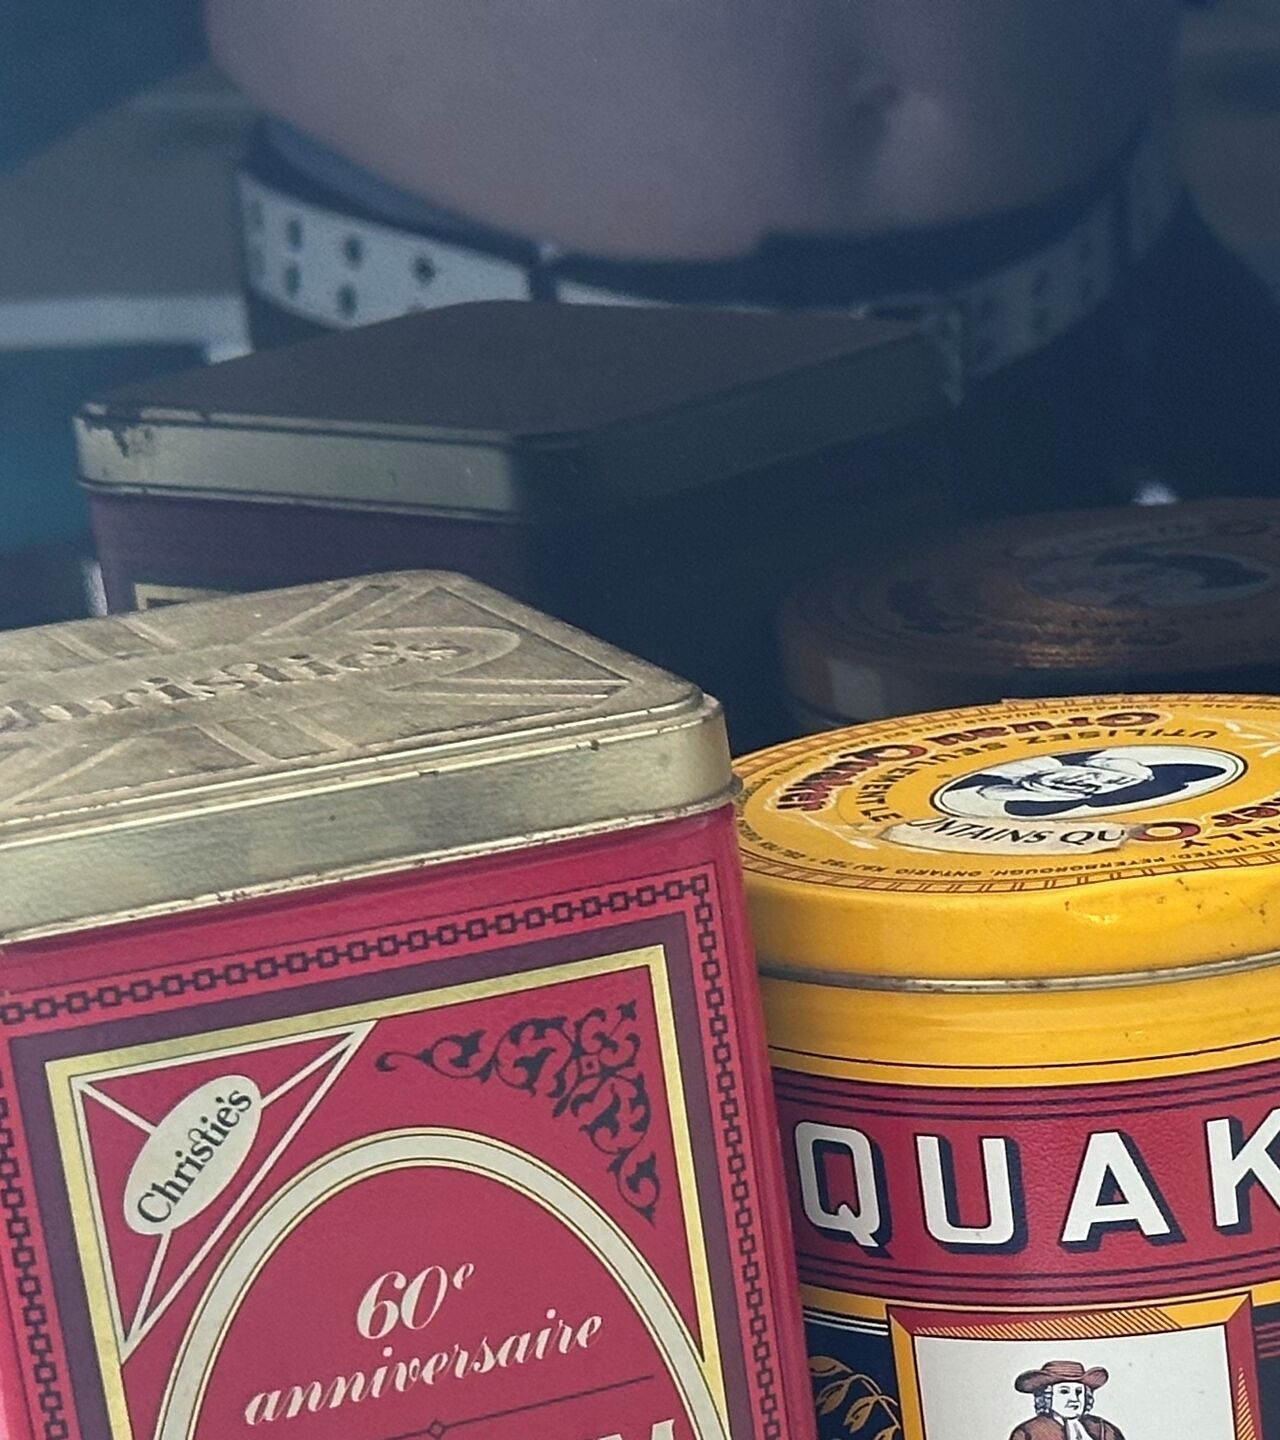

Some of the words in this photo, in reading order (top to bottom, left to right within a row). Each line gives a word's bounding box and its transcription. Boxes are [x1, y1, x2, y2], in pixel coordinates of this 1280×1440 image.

[0, 640, 471, 733] hristie's
[928, 712, 1162, 746] Gruau
[1027, 729, 1219, 745] UTILISEZ
[774, 744, 928, 812] Quaker
[851, 742, 1008, 808] SEULEMENT
[864, 809, 906, 823] LE
[895, 867, 982, 877] ONTARIO
[1172, 845, 1260, 860] LIMITED,
[135, 1087, 252, 1224] Christie's
[244, 1308, 603, 1426] anniversaire
